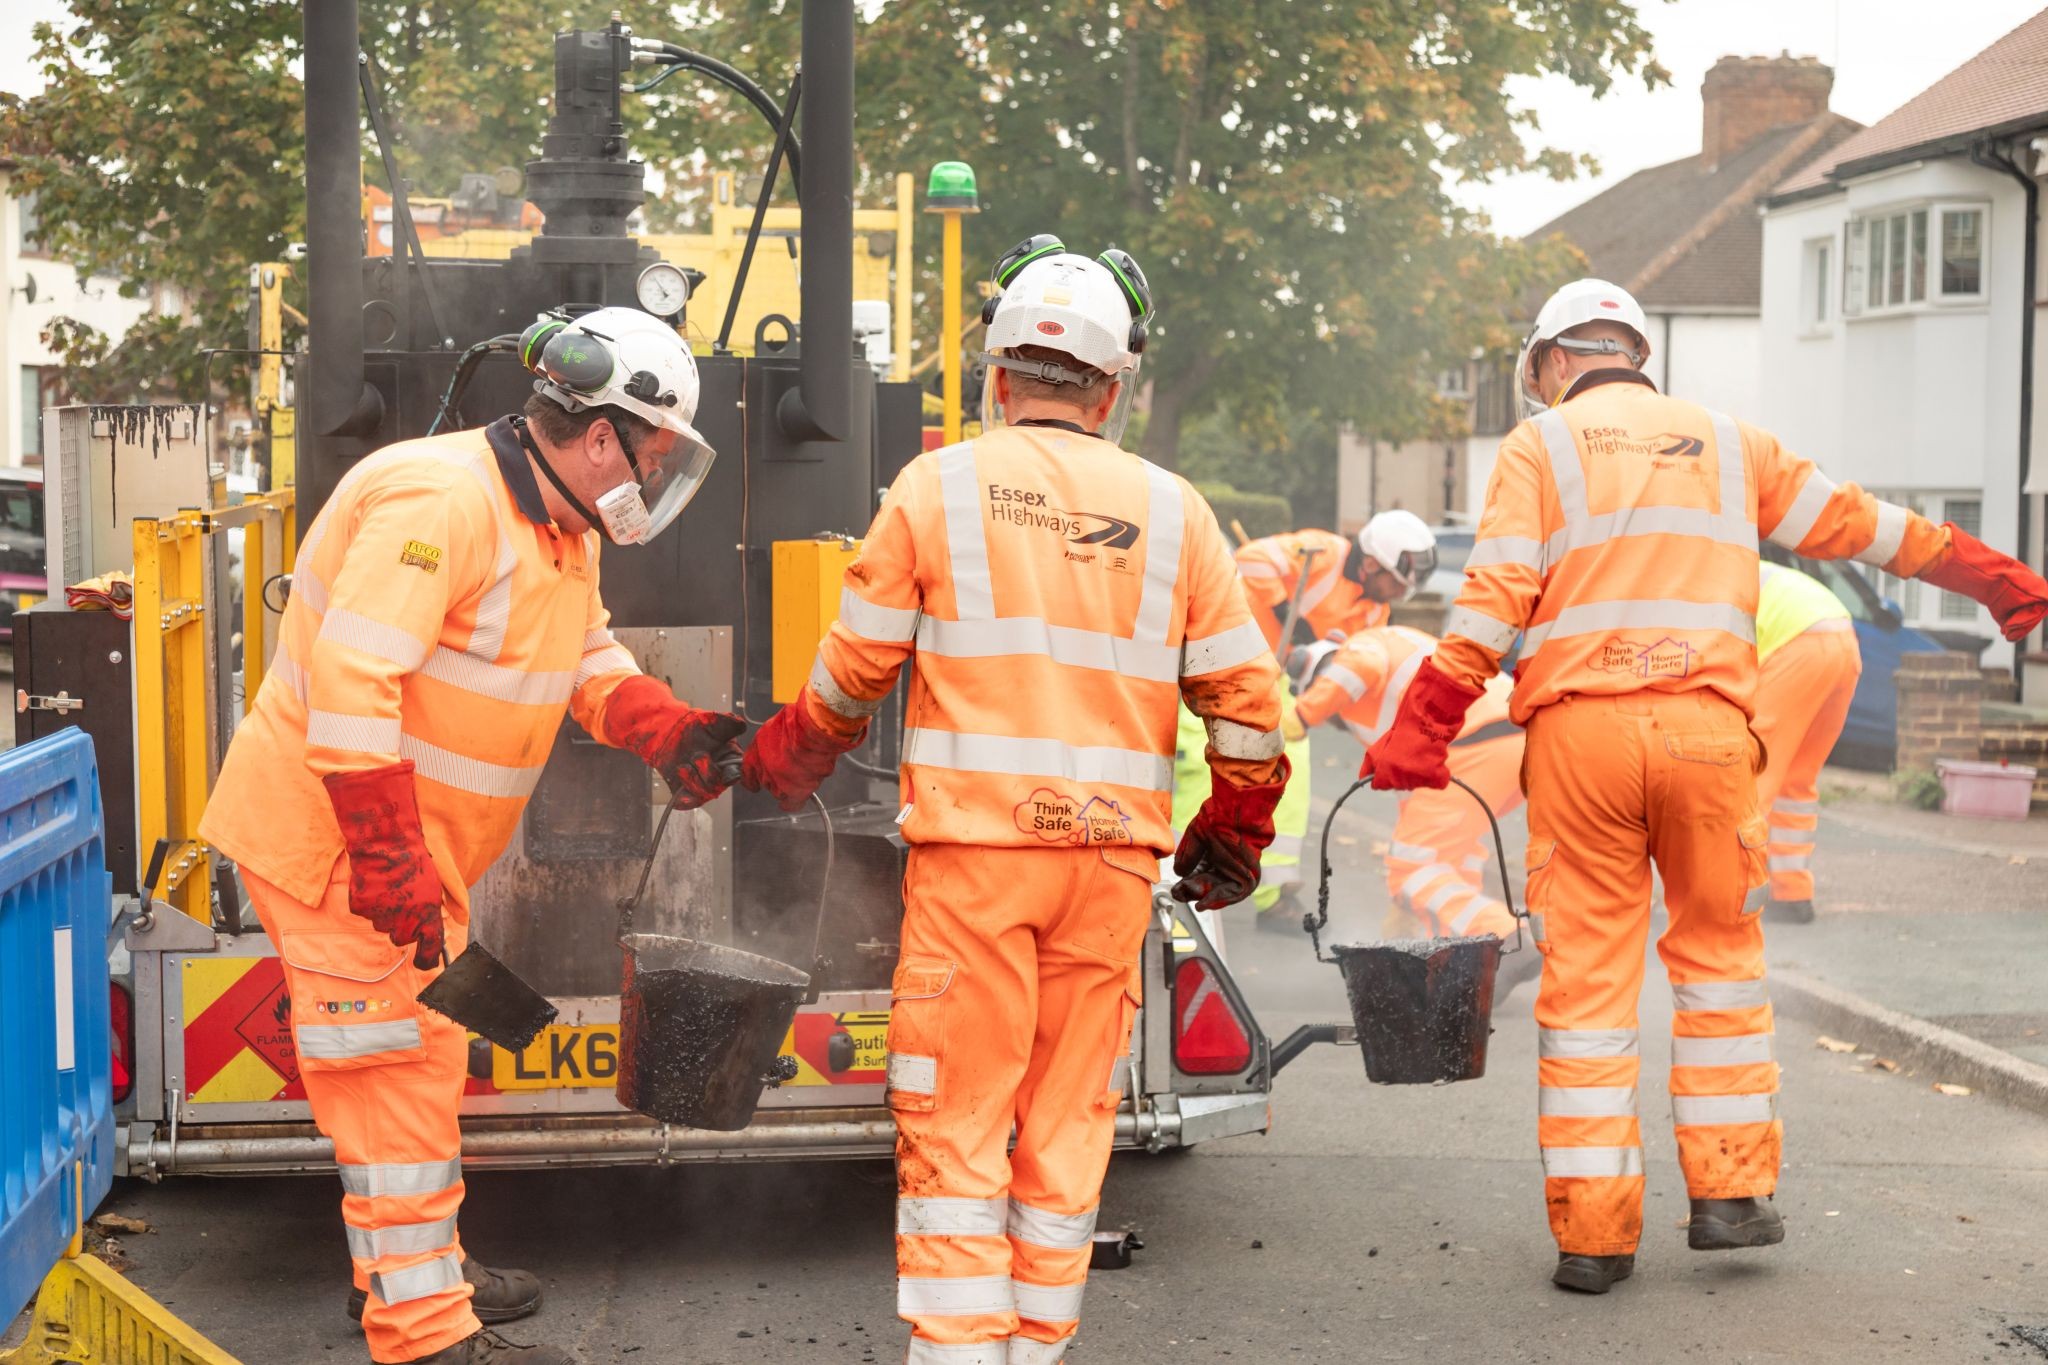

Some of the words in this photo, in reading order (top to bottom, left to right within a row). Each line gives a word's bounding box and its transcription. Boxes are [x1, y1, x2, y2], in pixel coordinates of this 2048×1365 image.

[1041, 324, 1061, 333] JSP
[1582, 427, 1630, 440] Essex
[1586, 438, 1662, 456] Highways
[988, 484, 1047, 507] Essex
[991, 503, 1081, 536] Highways
[1603, 646, 1633, 656] Think
[1602, 656, 1633, 667] Safe
[1651, 661, 1682, 671] Safe
[1033, 801, 1073, 816] Think
[1033, 816, 1072, 831] Safe
[1089, 815, 1119, 826] Home
[1093, 827, 1126, 841] Safe
[256, 1035, 294, 1045] FLAMM
[854, 1035, 888, 1050] auti
[280, 1048, 297, 1058] GA
[515, 1033, 617, 1080] LK6
[863, 1055, 888, 1067] Surf
[289, 1066, 296, 1076] 2
